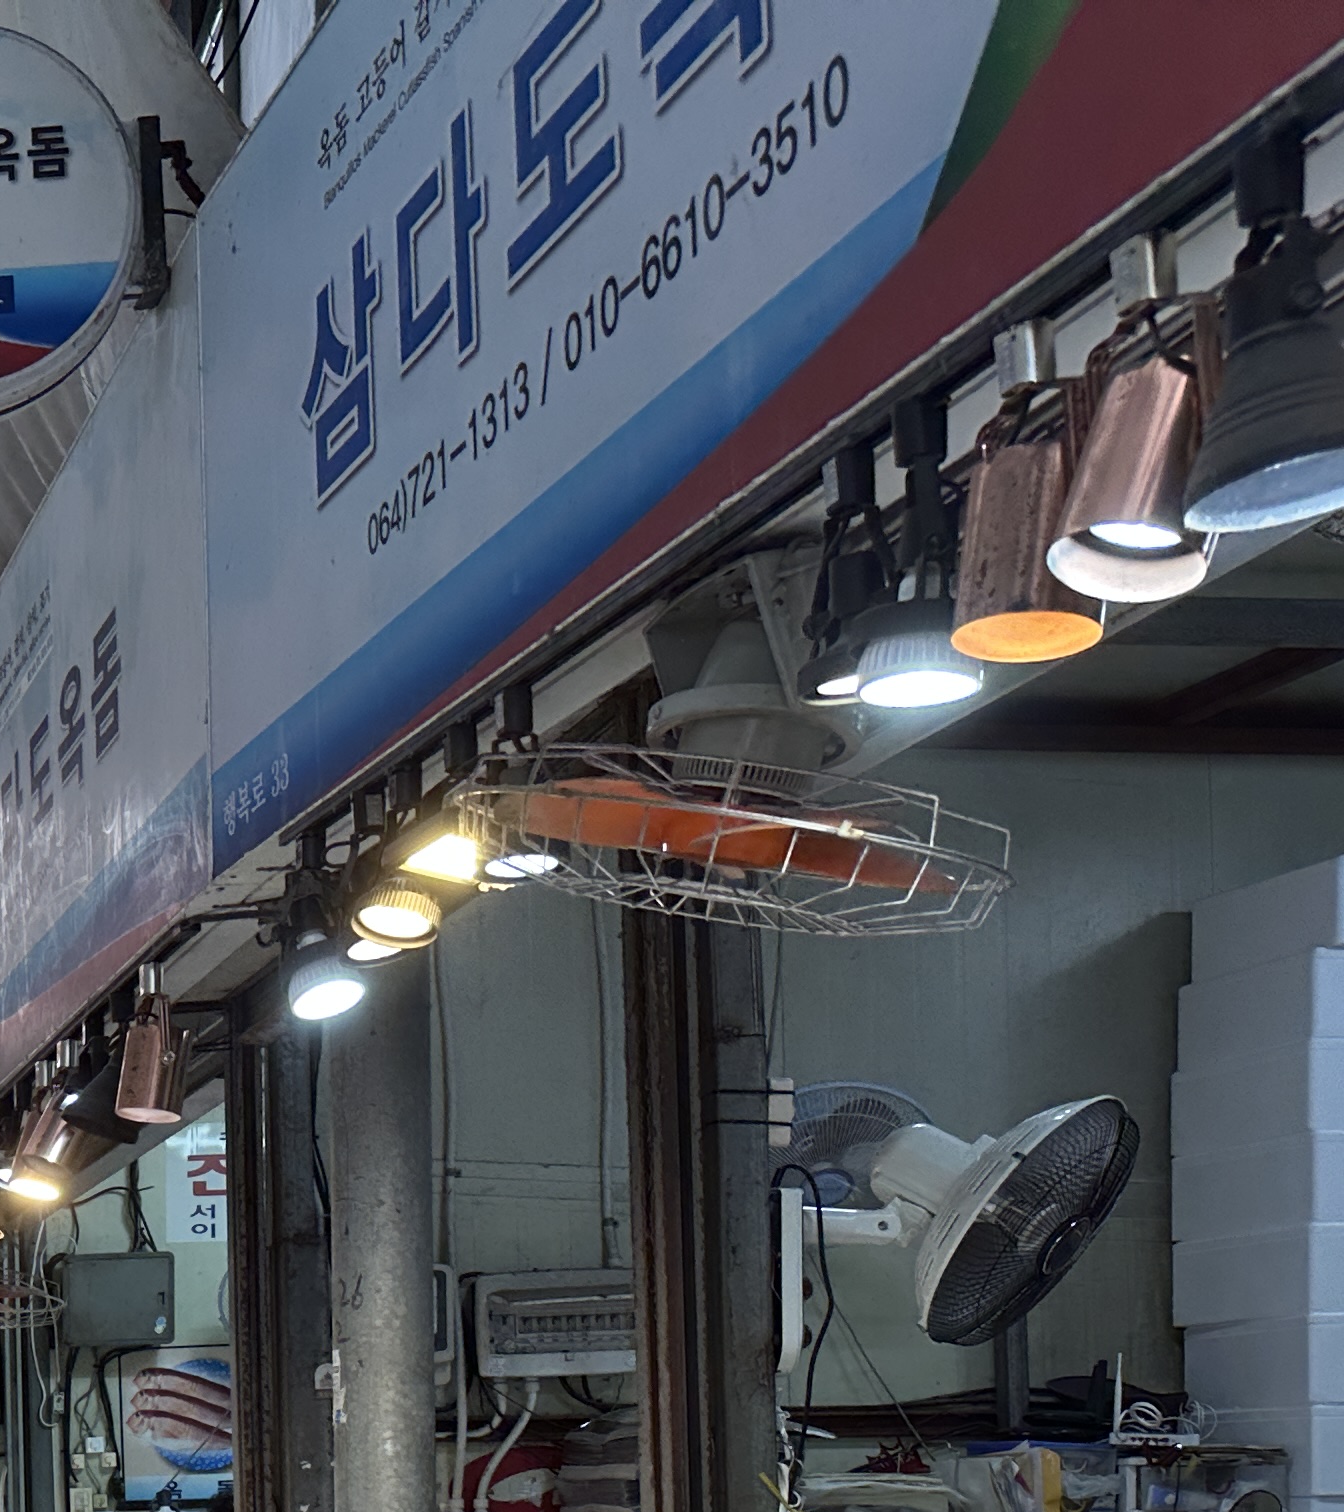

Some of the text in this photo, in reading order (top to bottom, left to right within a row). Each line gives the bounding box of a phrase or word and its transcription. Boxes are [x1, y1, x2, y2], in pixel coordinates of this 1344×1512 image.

[355, 19, 406, 122] 고등어
[366, 361, 530, 555] 064)721-1313
[562, 54, 851, 373] 010-6610-3510
[223, 753, 290, 837] 행복로 33
